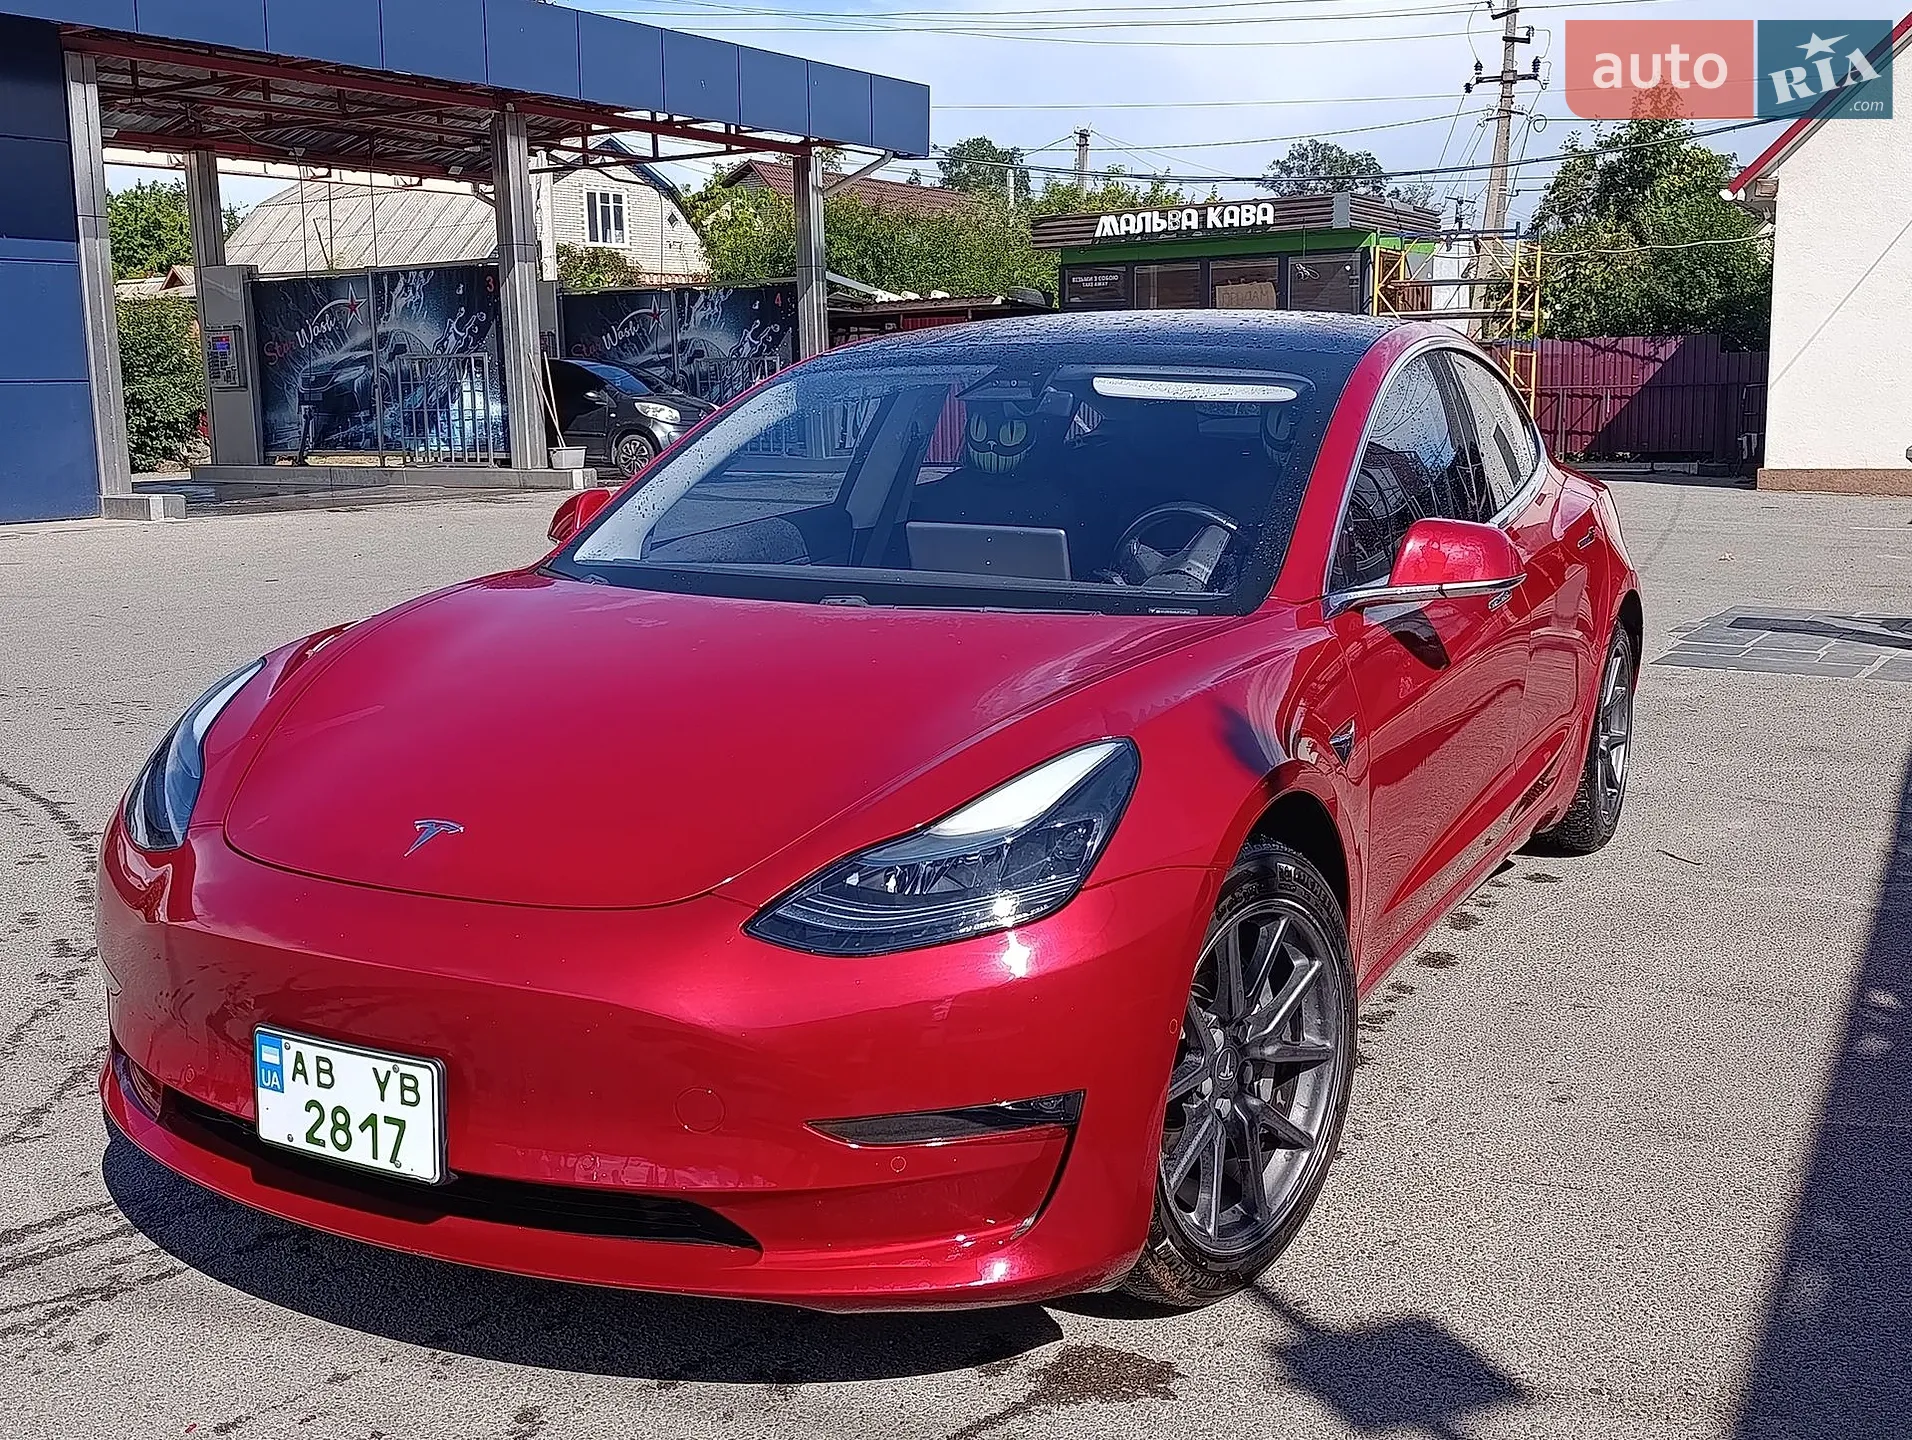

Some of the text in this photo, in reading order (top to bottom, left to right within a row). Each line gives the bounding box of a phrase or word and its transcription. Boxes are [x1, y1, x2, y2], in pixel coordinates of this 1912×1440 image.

[1094, 203, 1275, 238] МАЛЬВА КАВА
[486, 275, 494, 292] 3
[774, 292, 782, 307] 4
[296, 314, 336, 348] Wash
[602, 321, 640, 350] Wash
[261, 1068, 281, 1090] UA
[291, 1051, 421, 1107] AB YB
[304, 1099, 407, 1164] 2817
